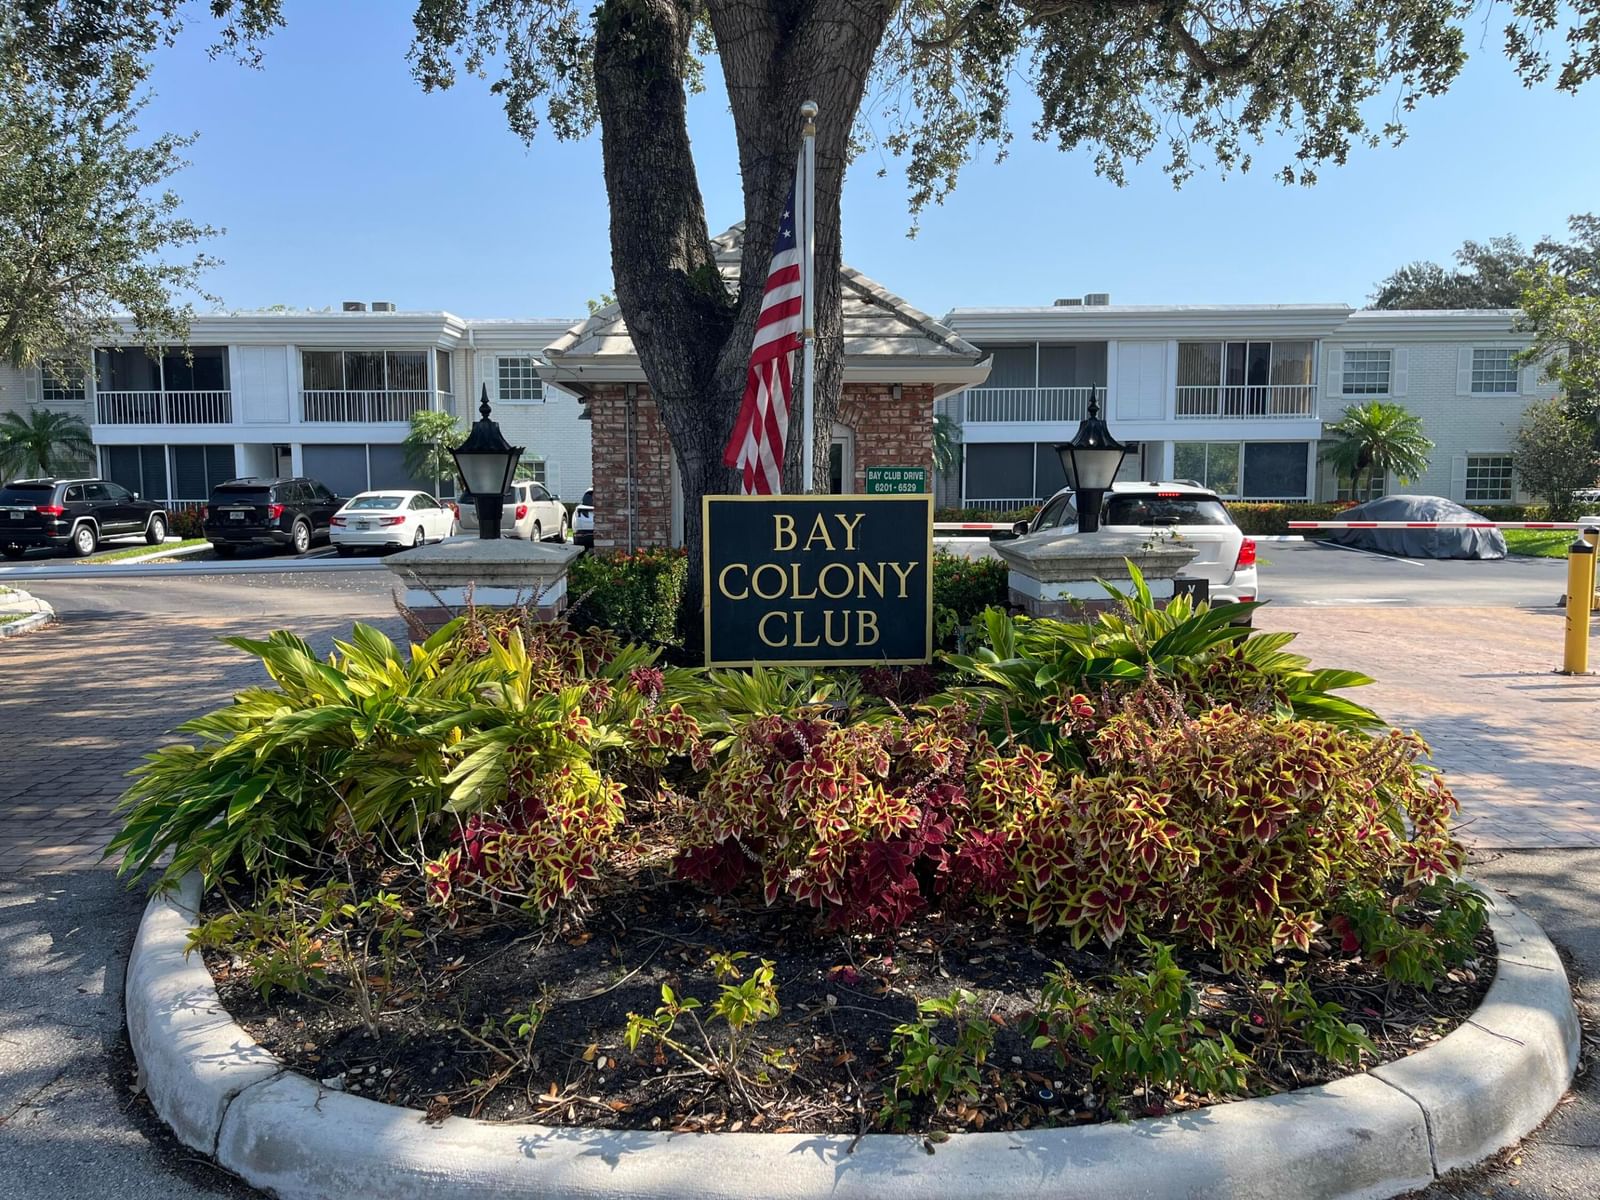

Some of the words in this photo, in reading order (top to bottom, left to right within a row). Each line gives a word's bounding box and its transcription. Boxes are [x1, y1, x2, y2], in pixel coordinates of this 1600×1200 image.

[868, 471, 882, 480] BAY
[883, 471, 902, 480] CLUB
[903, 471, 924, 480] DRIVE
[772, 513, 866, 551] BAY
[718, 562, 919, 600] COLONY
[758, 610, 880, 647] CLUB
